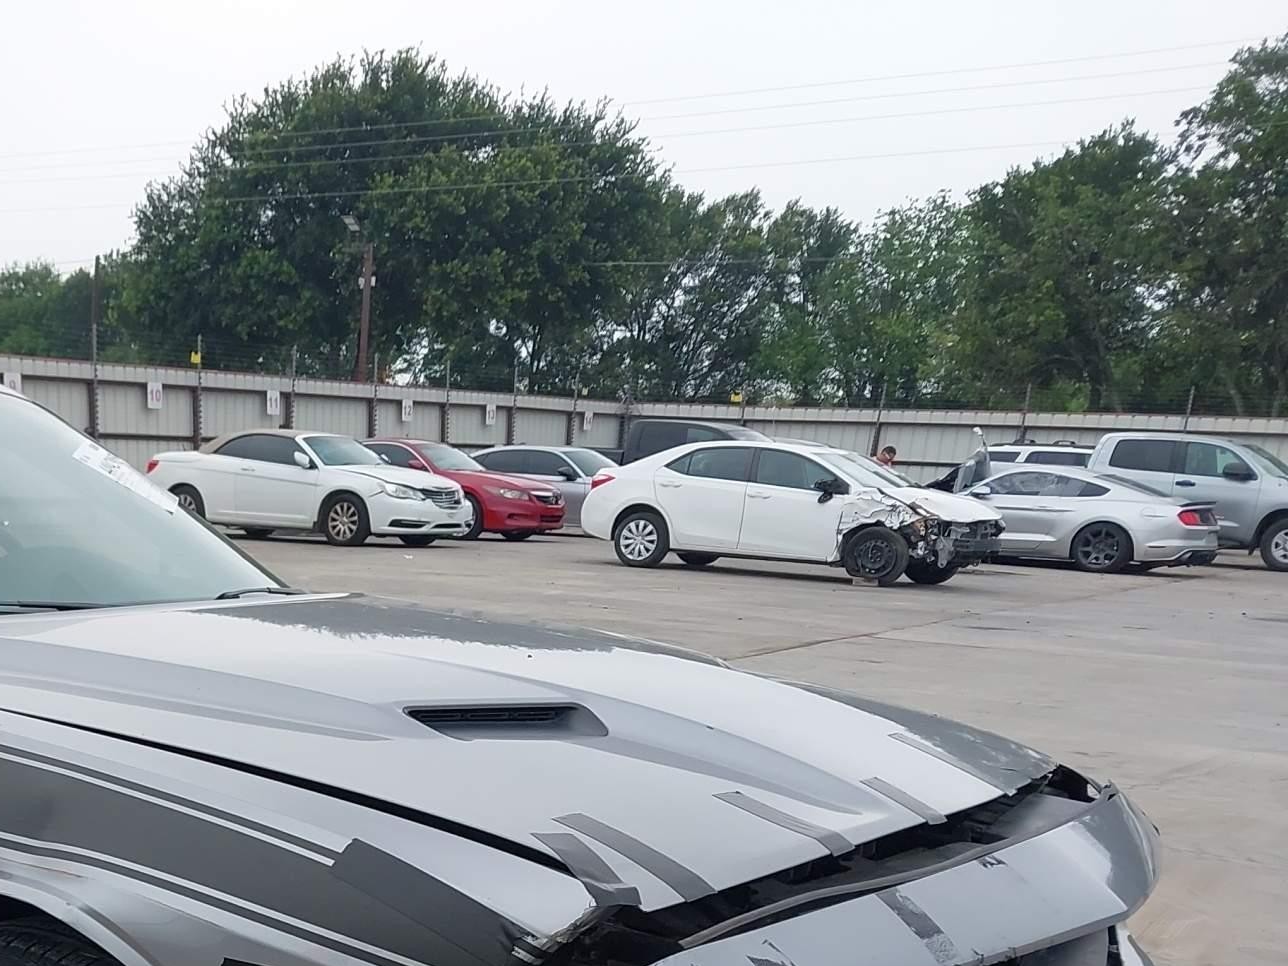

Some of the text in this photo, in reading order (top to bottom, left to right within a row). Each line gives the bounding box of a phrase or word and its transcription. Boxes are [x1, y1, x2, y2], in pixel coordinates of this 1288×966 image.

[150, 389, 162, 402] 10
[269, 397, 279, 409] 11
[403, 405, 413, 416] 12
